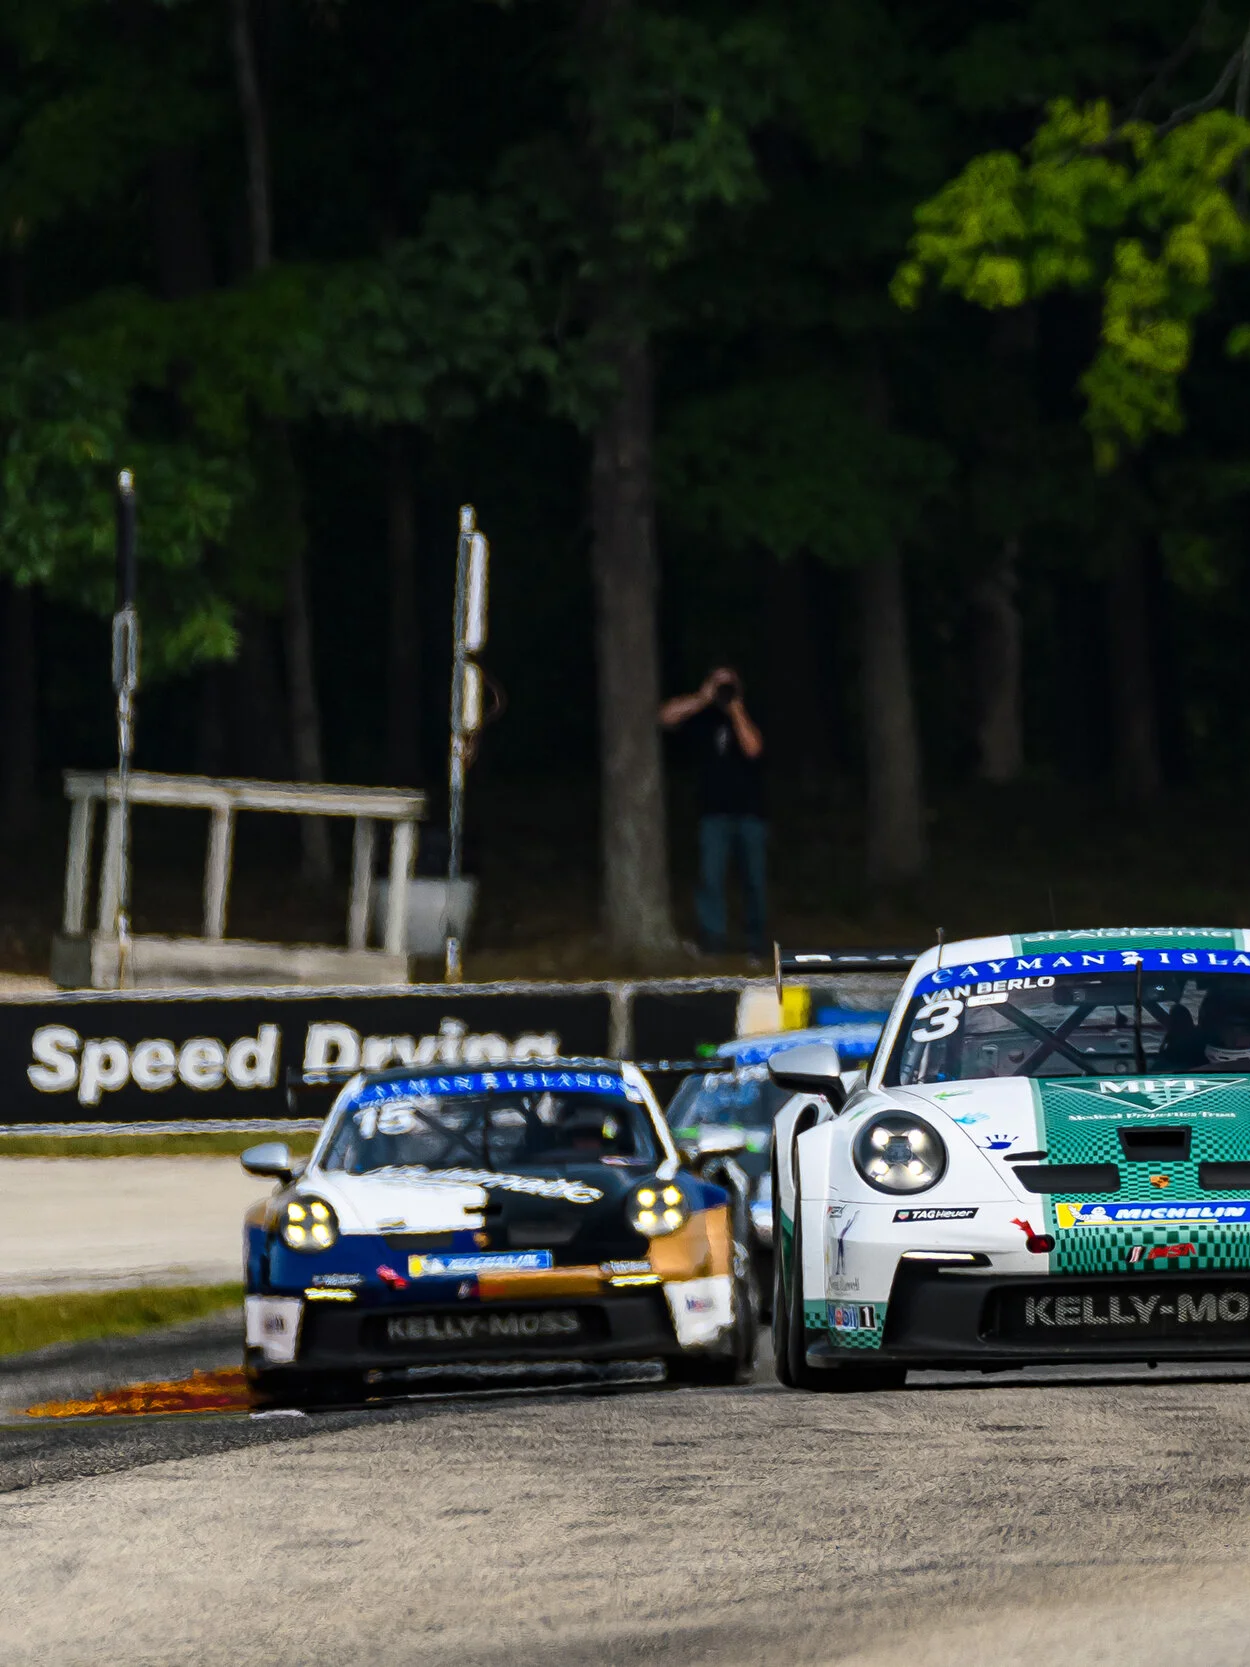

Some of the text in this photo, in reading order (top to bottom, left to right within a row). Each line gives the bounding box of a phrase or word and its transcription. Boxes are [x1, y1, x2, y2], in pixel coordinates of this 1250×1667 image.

[931, 954, 1105, 984] CAYMAN
[922, 976, 1056, 1005] VAN BERLO
[911, 1000, 965, 1043] 3
[27, 1022, 282, 1107] Speed
[352, 1101, 417, 1140] 15
[1115, 1206, 1247, 1220] MICHELIN
[828, 1304, 872, 1329] Mobil 1
